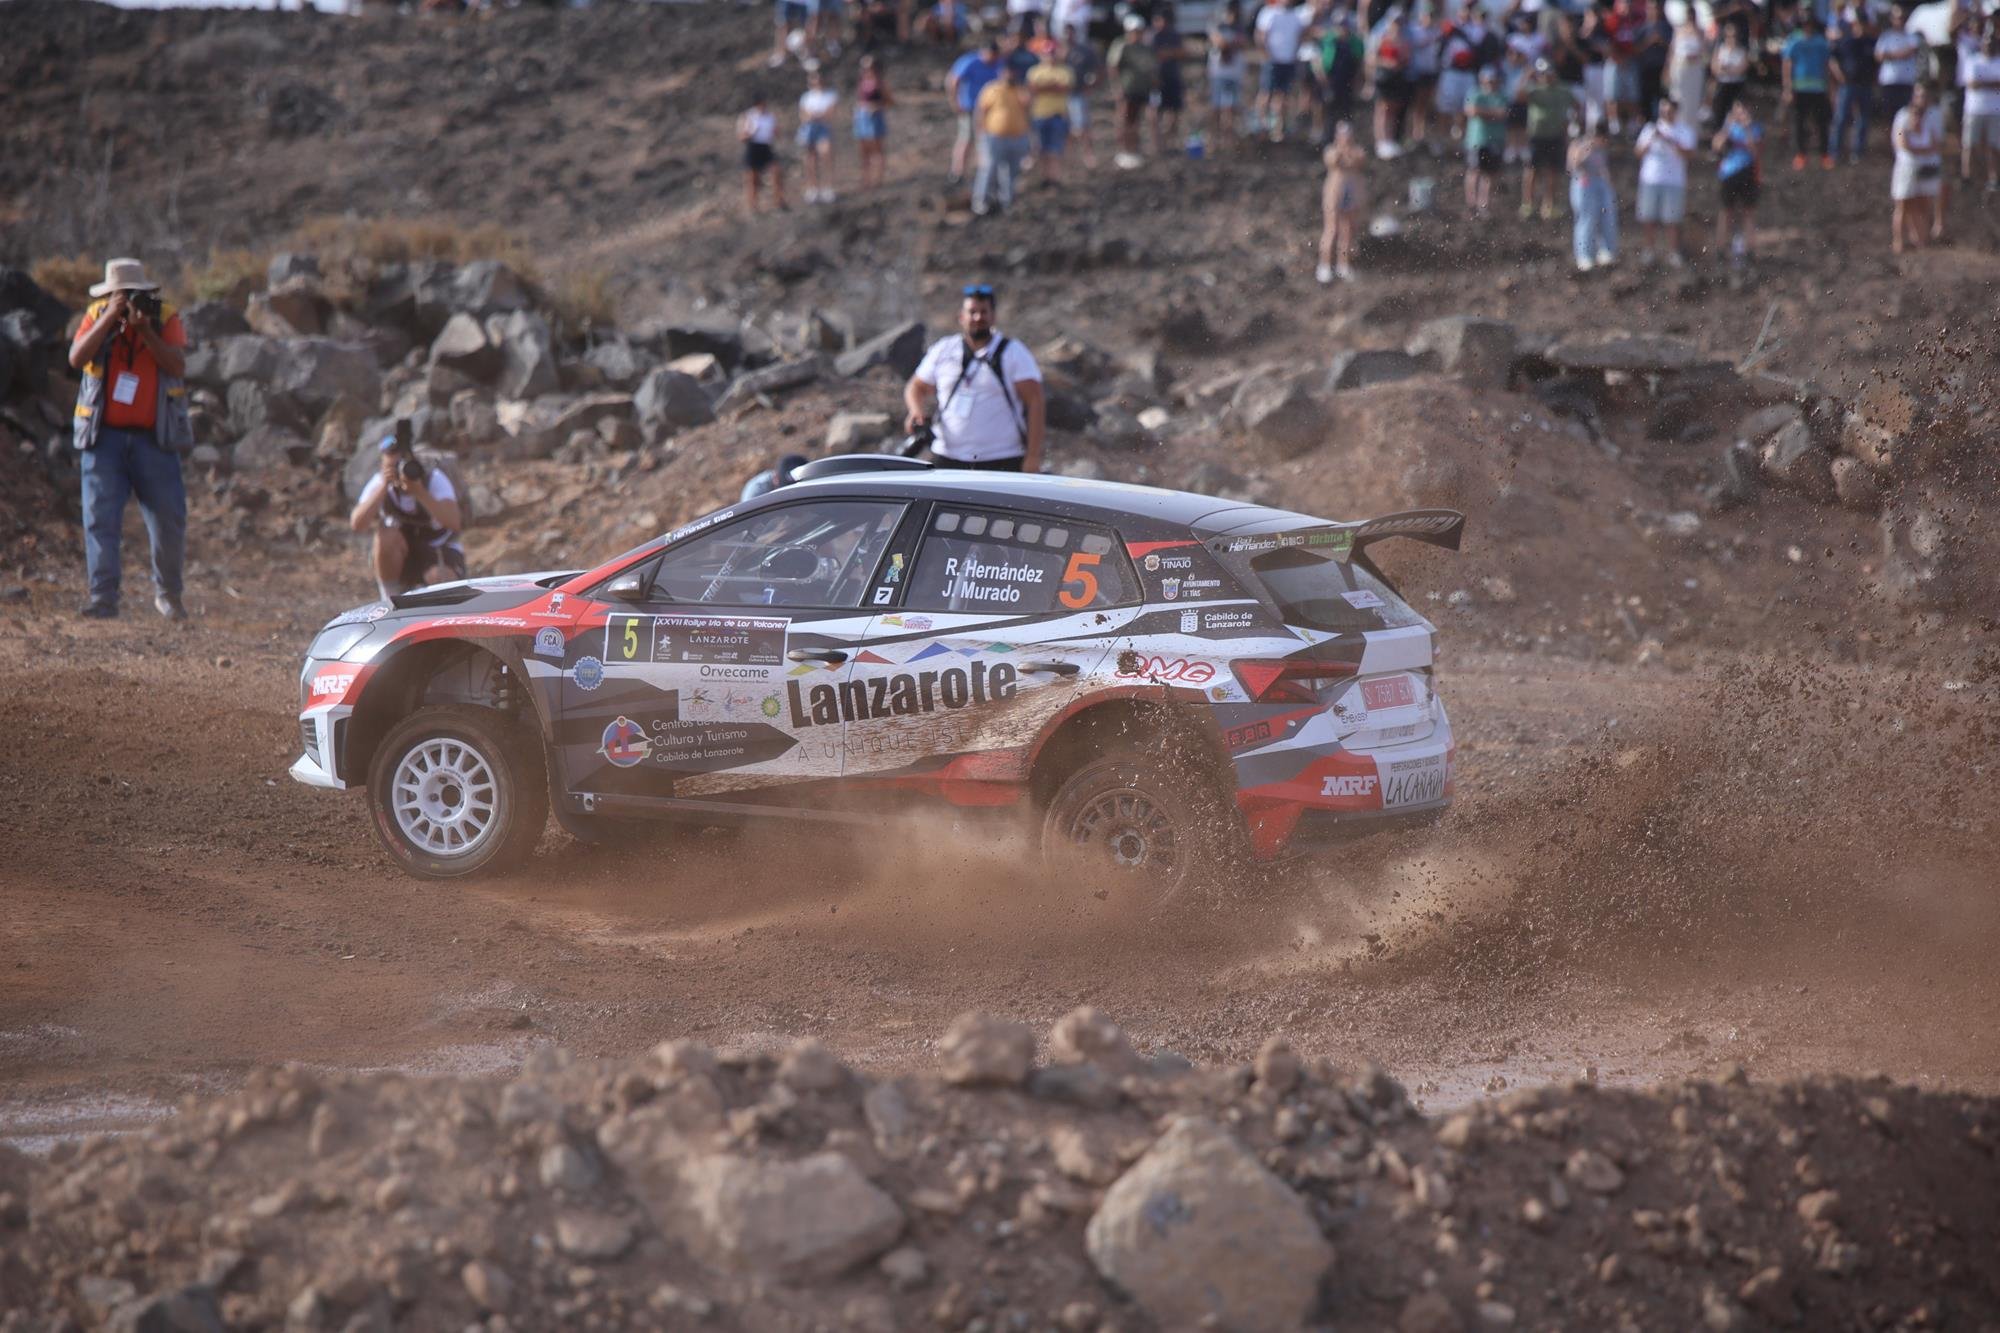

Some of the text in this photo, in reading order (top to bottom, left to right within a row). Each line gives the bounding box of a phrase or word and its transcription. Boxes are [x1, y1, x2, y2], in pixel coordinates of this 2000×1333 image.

[945, 558, 1045, 583] R. Hernández
[1162, 560, 1192, 569] TINAJO
[1058, 552, 1102, 609] 5
[1182, 579, 1221, 588] AYUNTAMIENTO
[941, 580, 1021, 603] J. Murado
[657, 617, 682, 626] XXVII
[683, 618, 707, 627] Rallye
[753, 620, 787, 629] Volcanes
[1204, 612, 1253, 622] Cabildo de
[1205, 620, 1251, 629] Lanzarote
[543, 634, 557, 647] FCA
[623, 618, 639, 659] 5
[689, 635, 749, 645] LANZAROTE
[700, 664, 769, 678] Orvecame
[312, 674, 354, 697] MRF
[786, 660, 1018, 729] Lanzarote
[654, 728, 748, 747] Cultura y Turismo
[656, 746, 744, 762] Cabildo de Lanzarote
[798, 746, 809, 762] A
[824, 731, 914, 759] UNIQUE
[1321, 776, 1377, 796] MRF
